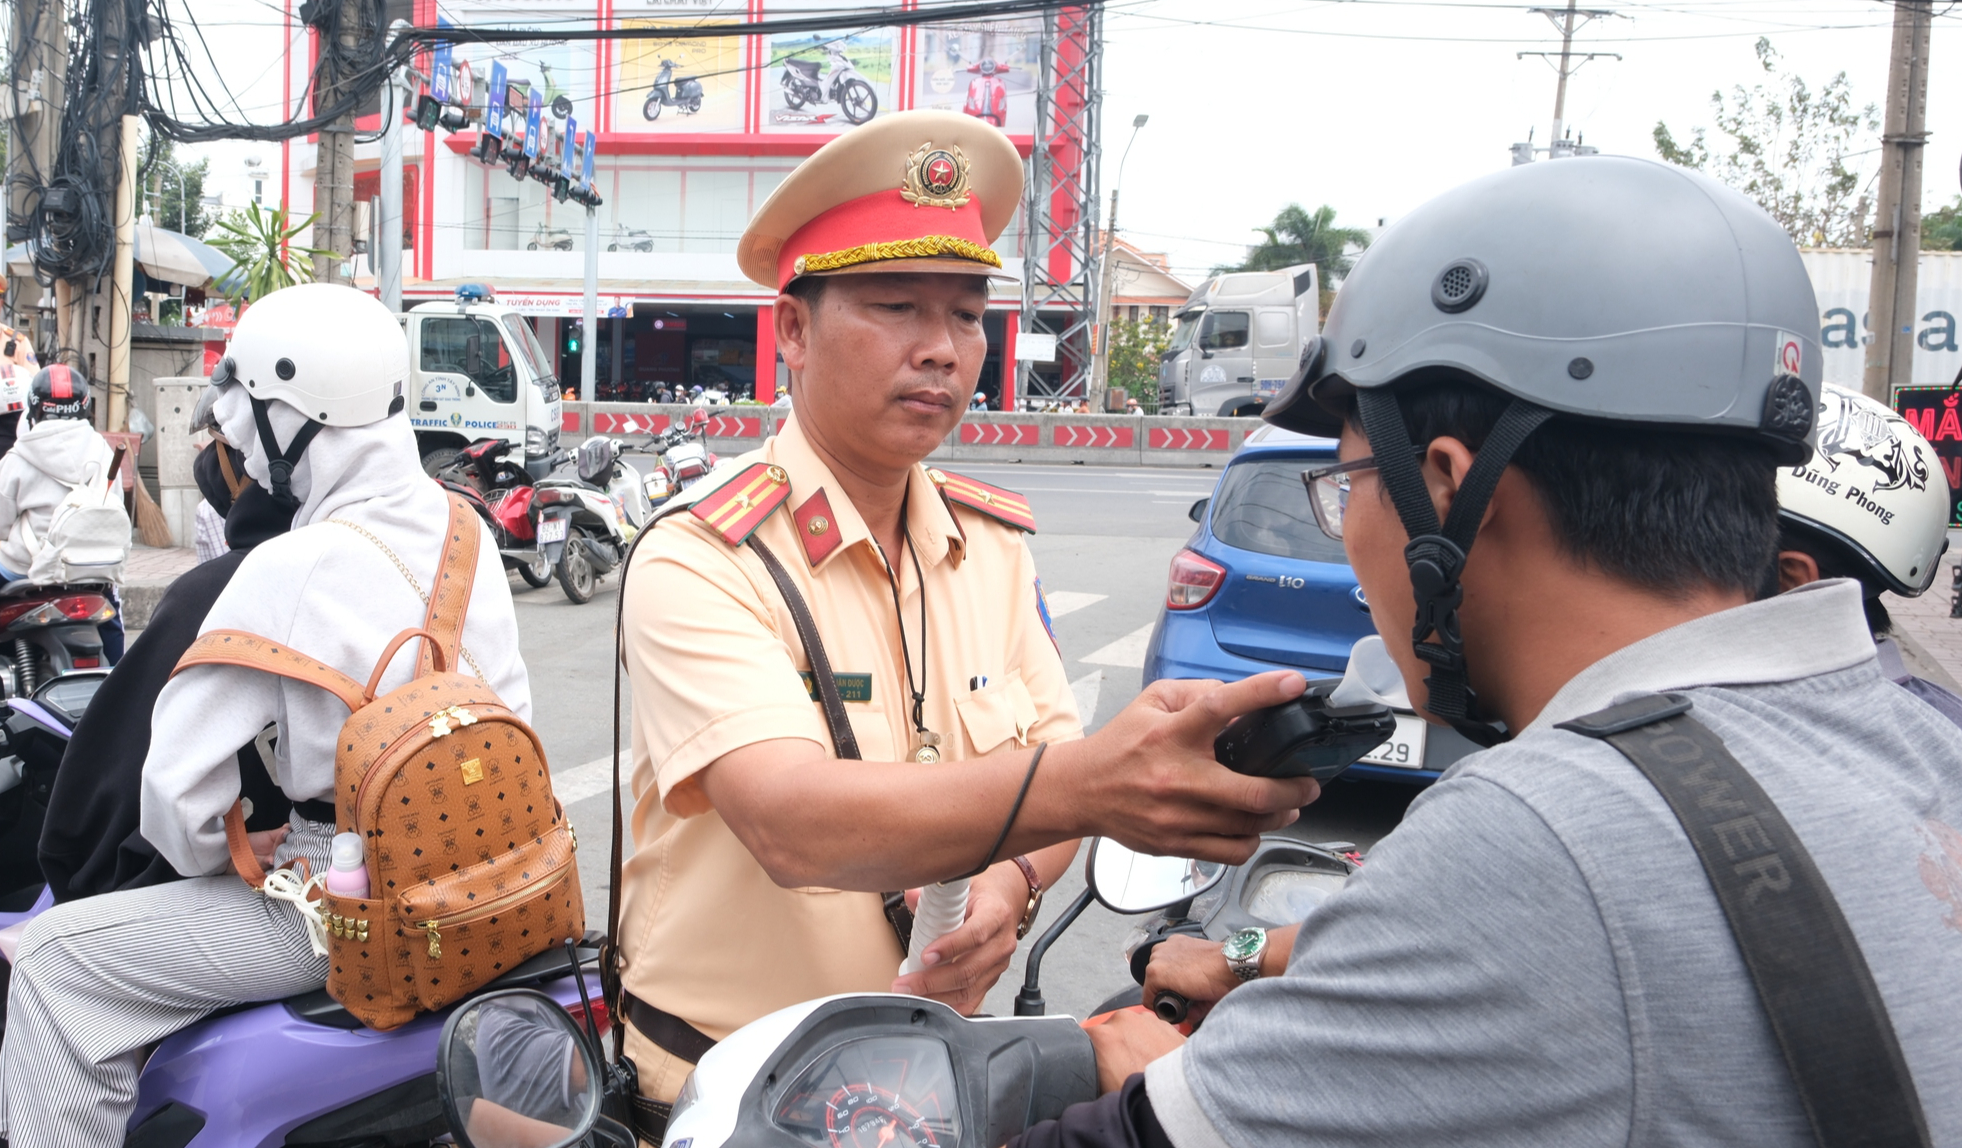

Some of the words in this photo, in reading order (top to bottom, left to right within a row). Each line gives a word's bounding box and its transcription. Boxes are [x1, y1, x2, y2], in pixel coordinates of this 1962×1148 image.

[506, 297, 534, 306] TUYỂN
[536, 299, 560, 308] DỤNG
[56, 400, 81, 413] PHỐ
[1792, 466, 1841, 496] Dũng
[1845, 486, 1895, 526] Phong
[1279, 575, 1305, 589] i10
[846, 690, 861, 698] 211
[848, 1096, 859, 1106] 80
[866, 1095, 878, 1104] 100
[837, 1109, 849, 1119] 60
[838, 1125, 850, 1134] 40
